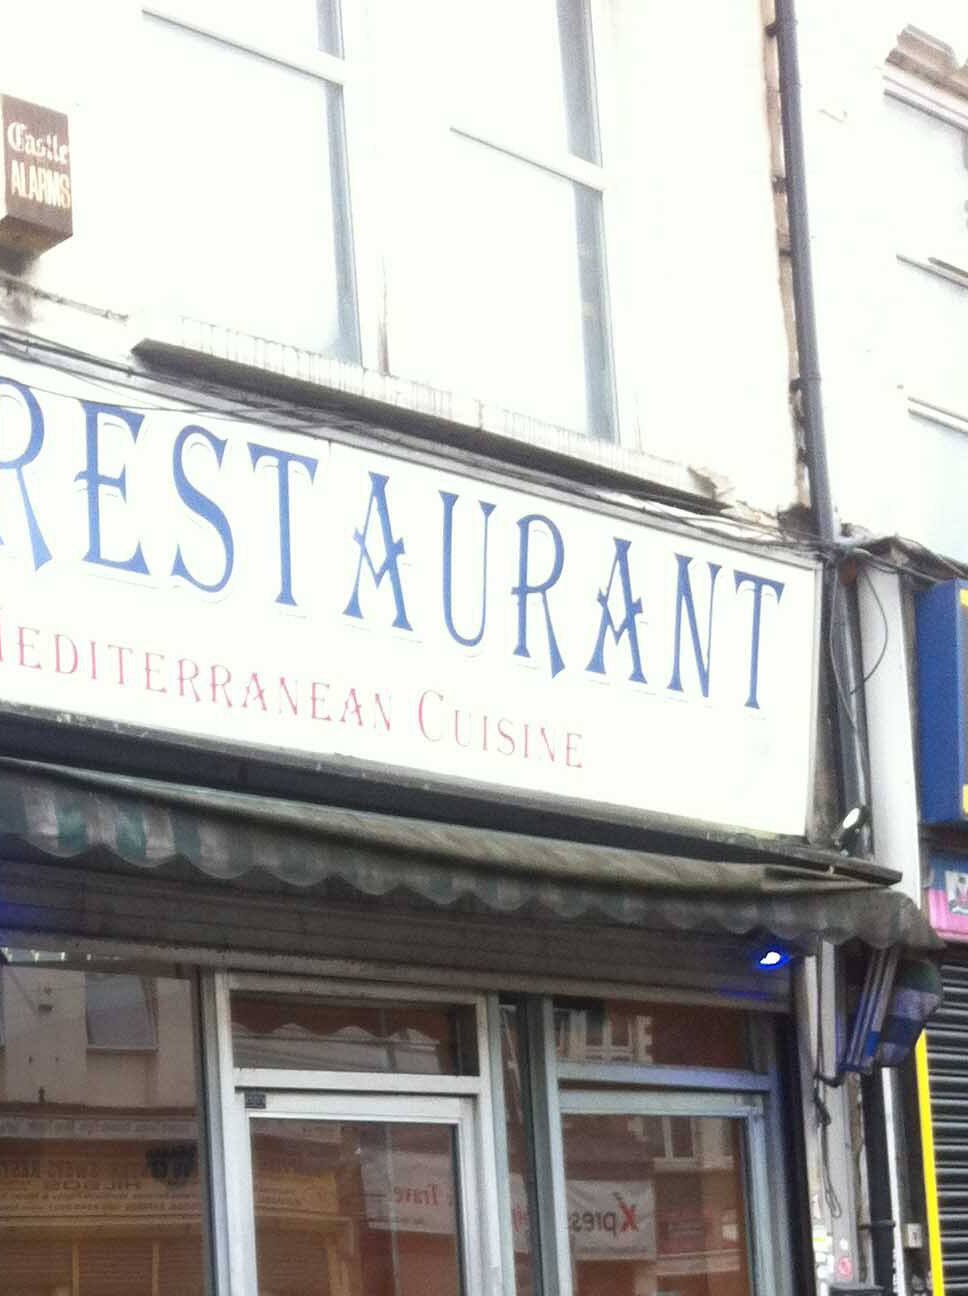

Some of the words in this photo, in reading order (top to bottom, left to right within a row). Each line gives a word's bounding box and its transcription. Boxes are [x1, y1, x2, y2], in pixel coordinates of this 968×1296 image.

[7, 121, 68, 165] Castle
[11, 159, 71, 208] ALARMS
[418, 689, 583, 769] CUISINE
